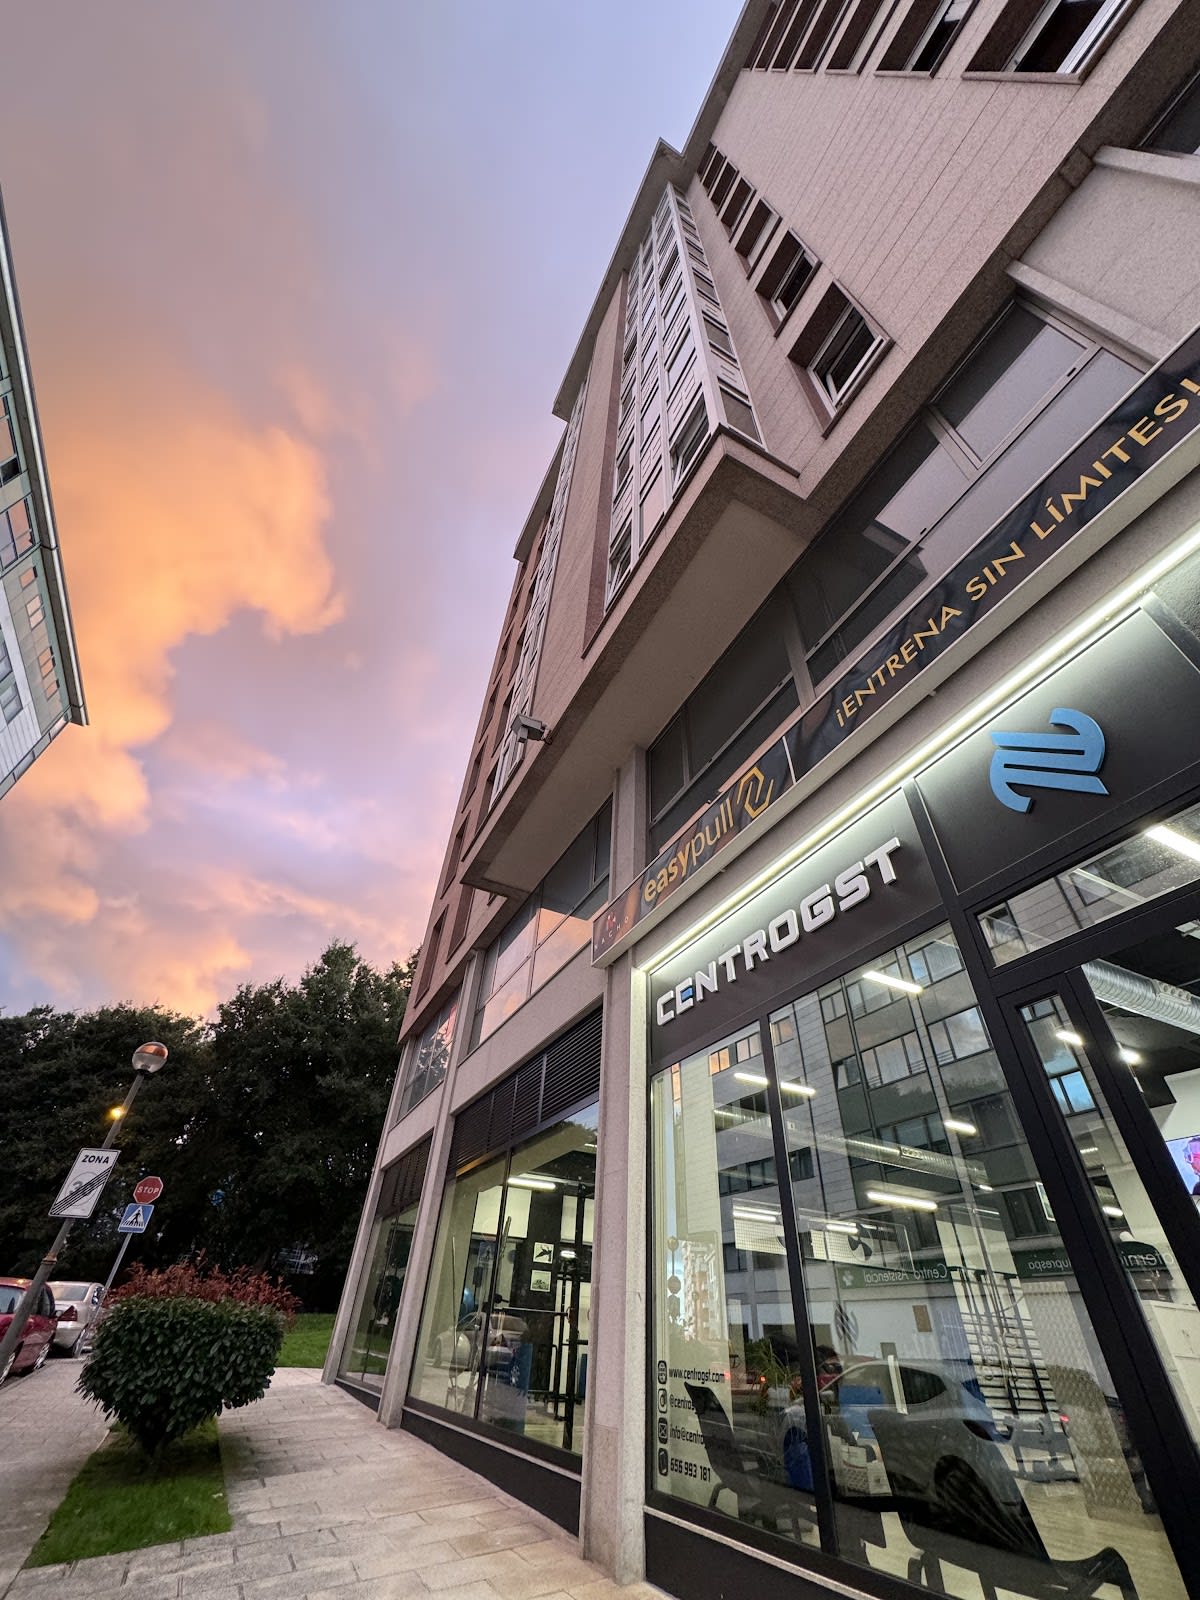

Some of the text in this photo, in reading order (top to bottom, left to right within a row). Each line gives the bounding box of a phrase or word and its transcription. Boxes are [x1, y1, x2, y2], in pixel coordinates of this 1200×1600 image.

[965, 541, 1026, 601] SIN
[643, 798, 735, 902] easypull
[657, 836, 901, 1027] CENTROGST
[81, 1155, 110, 1165] ZONA
[137, 1186, 160, 1195] STOP
